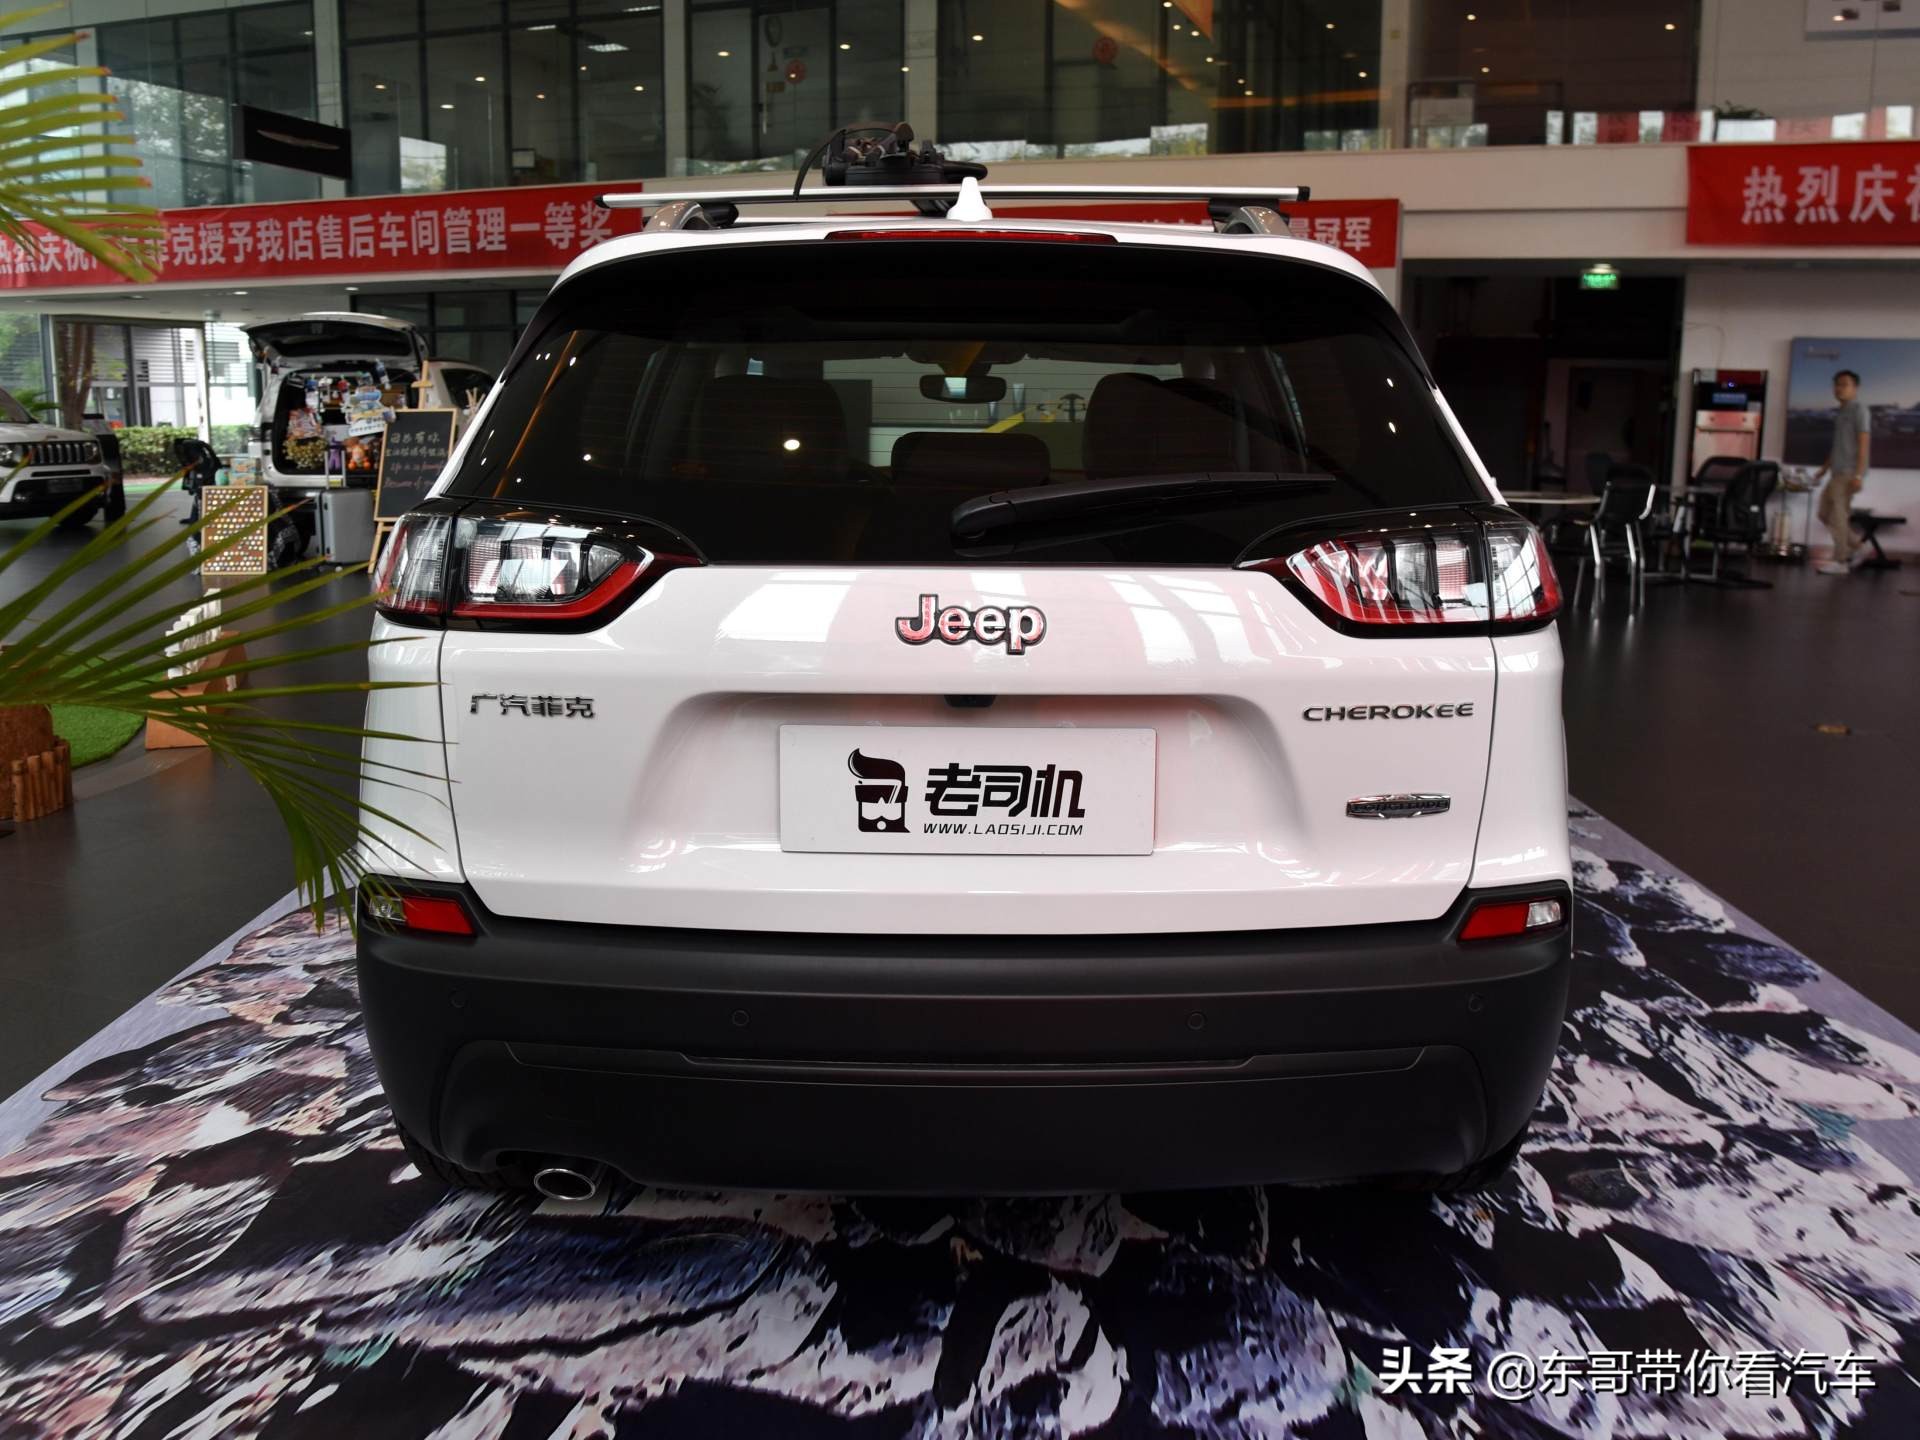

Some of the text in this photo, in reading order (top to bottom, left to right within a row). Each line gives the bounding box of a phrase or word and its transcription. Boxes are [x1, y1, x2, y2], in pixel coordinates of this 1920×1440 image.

[895, 594, 1046, 655] Jeep
[470, 693, 595, 718] 广汽菲克
[1302, 702, 1474, 721] CHEROKEE
[924, 762, 1086, 818] 老司机
[923, 822, 1084, 836] WWW.LAOSIJI.COM
